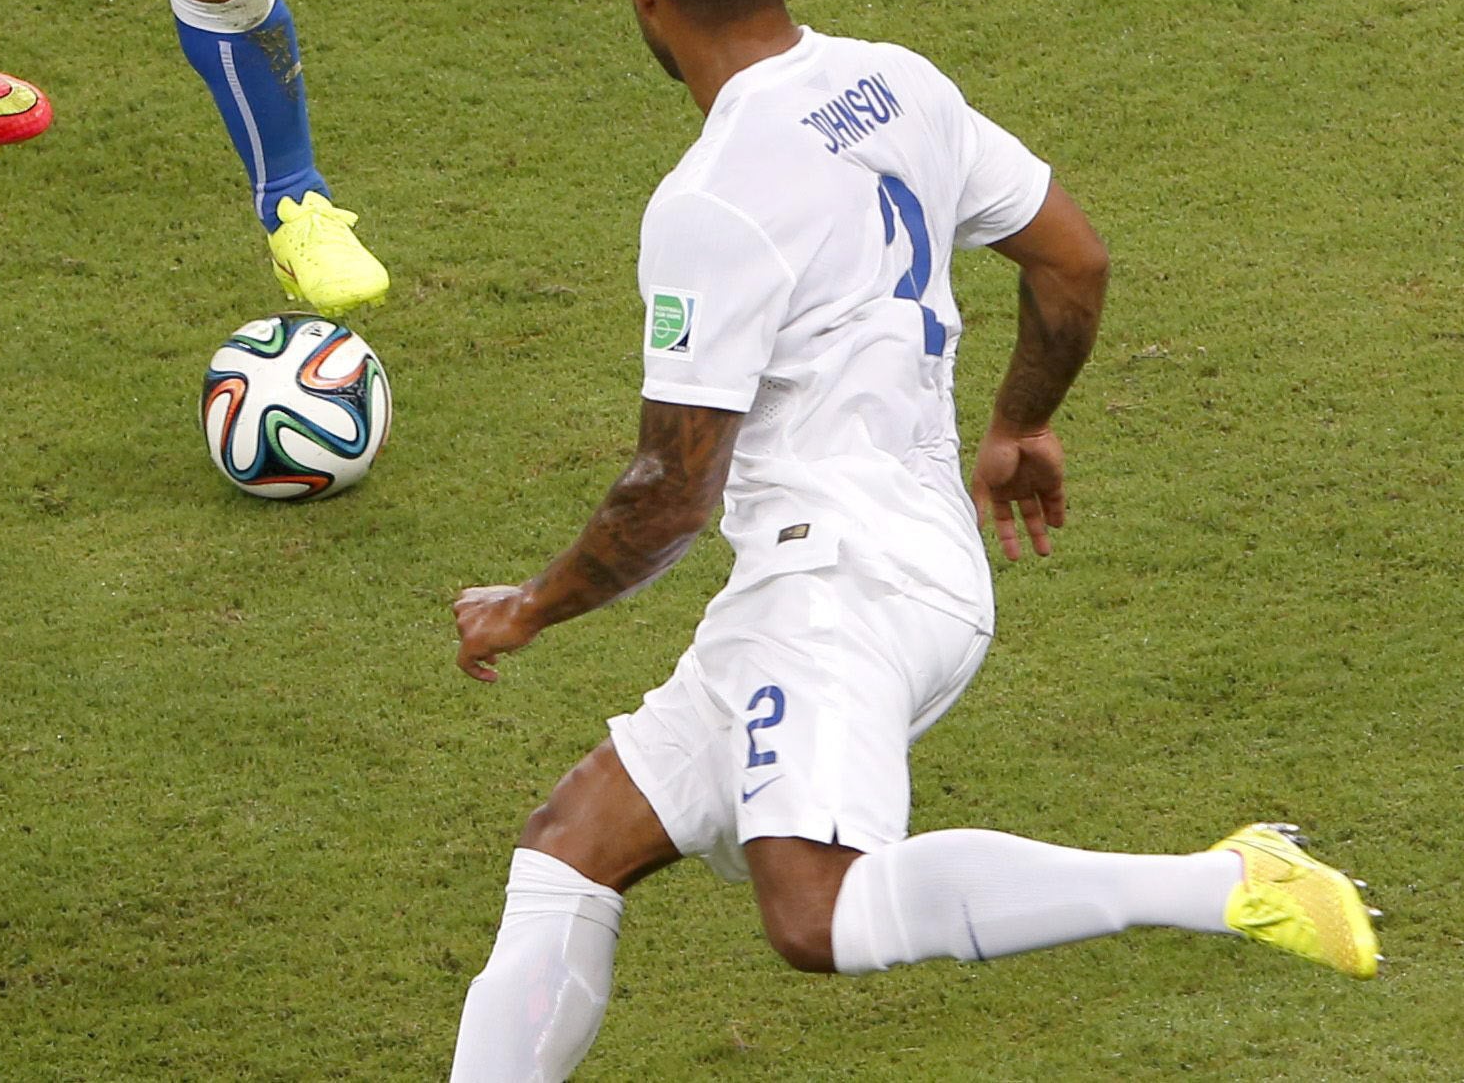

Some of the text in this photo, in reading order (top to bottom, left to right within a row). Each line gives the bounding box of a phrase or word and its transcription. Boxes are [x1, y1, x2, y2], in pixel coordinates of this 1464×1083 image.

[800, 72, 906, 155] JOHNSON
[877, 174, 947, 357] 2
[744, 685, 785, 769] 2
